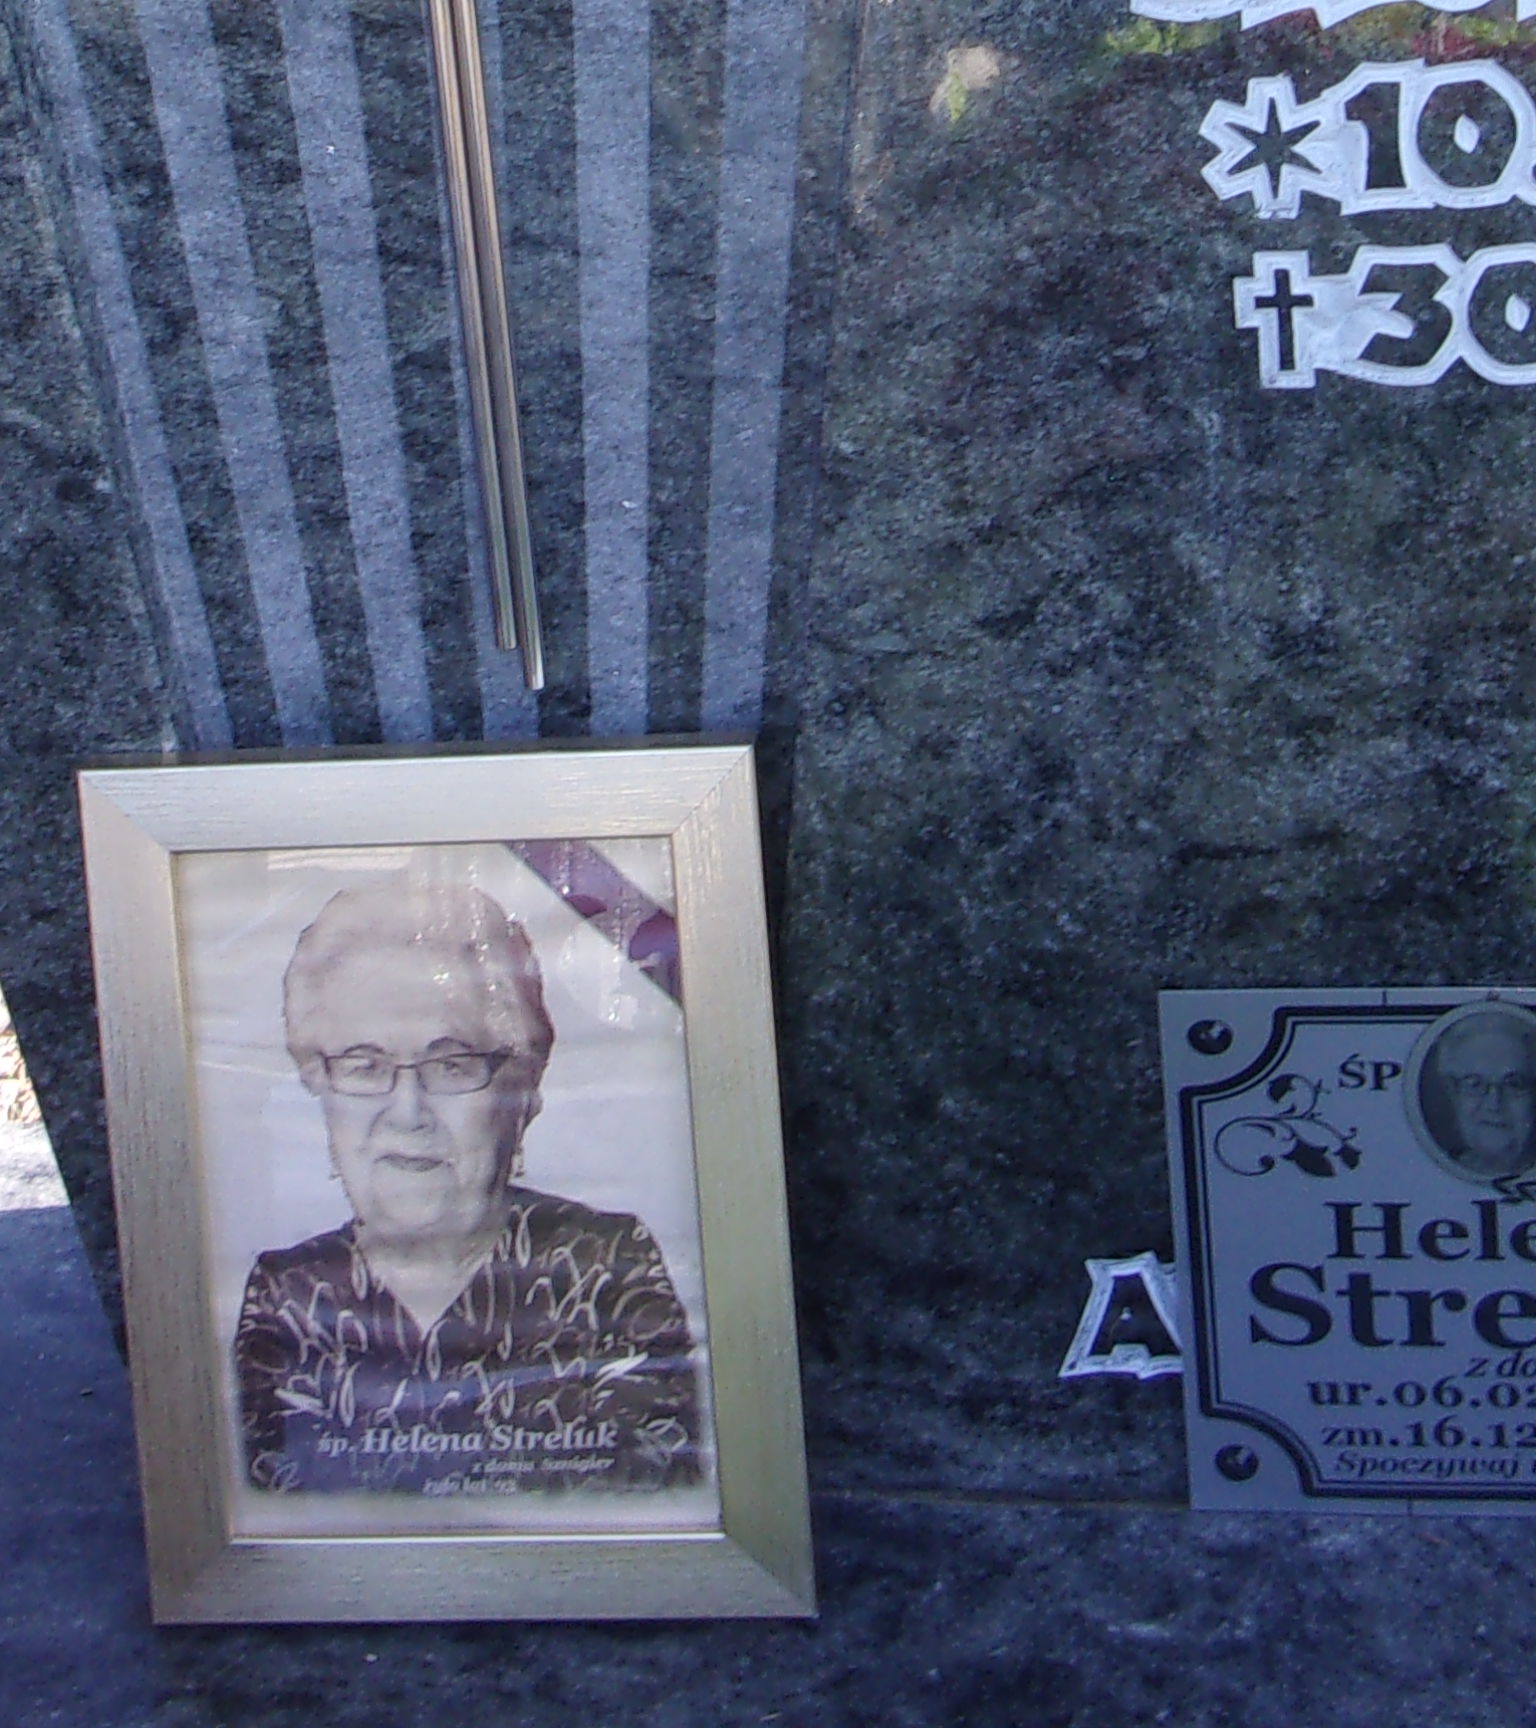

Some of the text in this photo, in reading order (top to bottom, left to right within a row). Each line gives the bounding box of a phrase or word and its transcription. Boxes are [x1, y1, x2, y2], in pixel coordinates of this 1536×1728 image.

[1338, 1054, 1402, 1091] ŚP
[1465, 1356, 1492, 1379] z
[363, 1424, 483, 1454] Helena
[488, 1419, 619, 1453] Streluk
[1336, 1450, 1520, 1479] Spoczywaj
